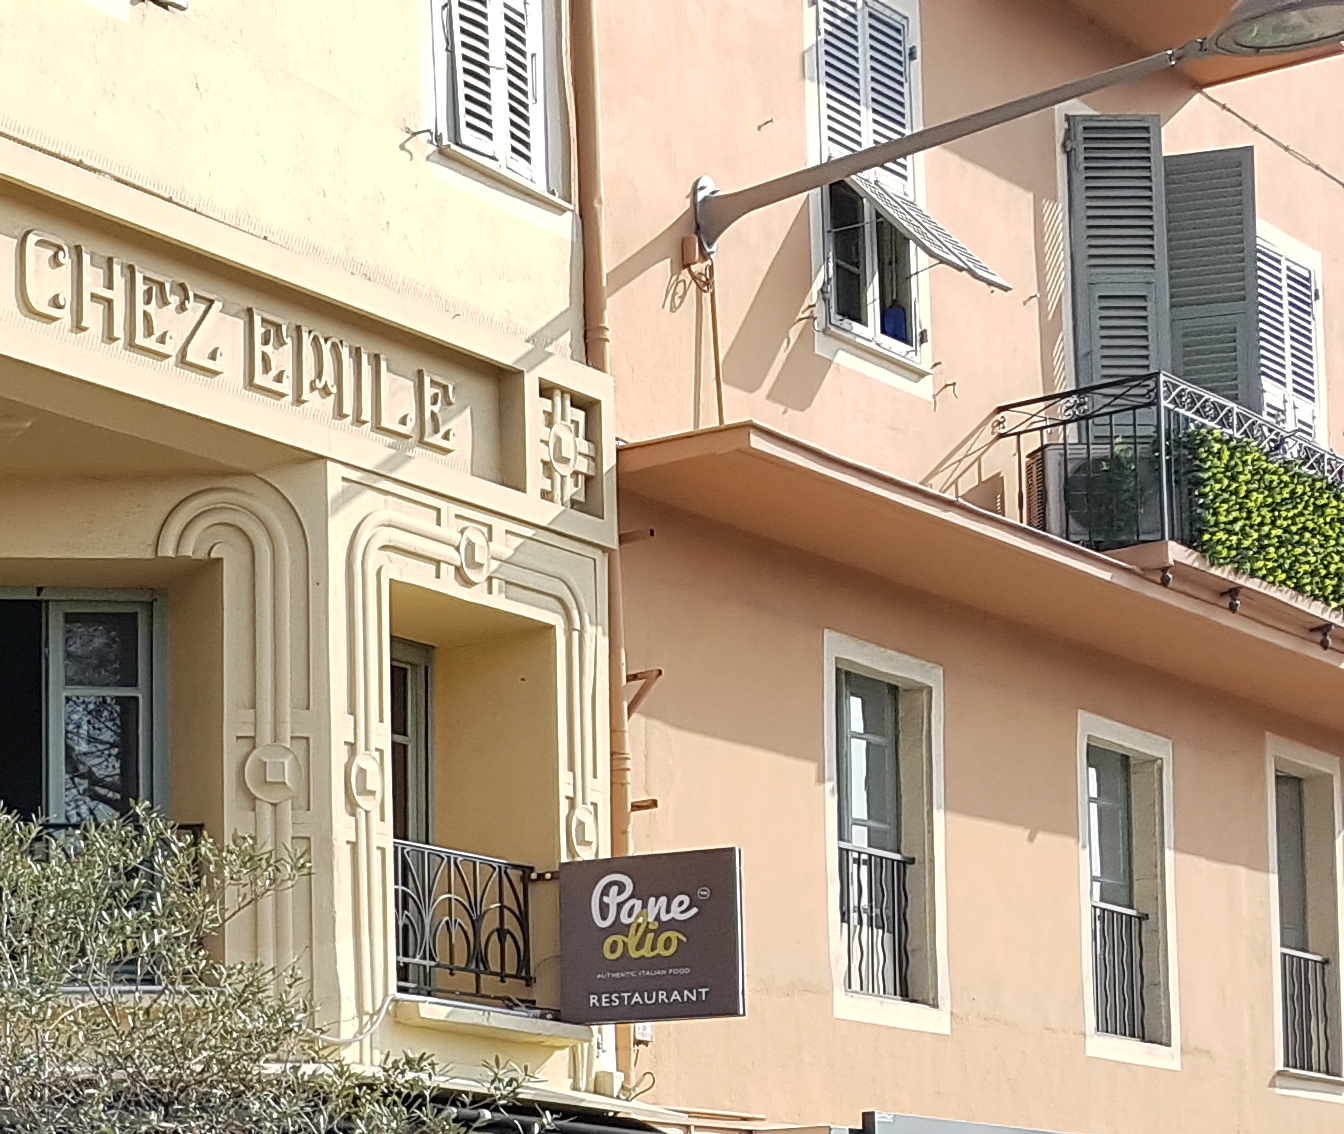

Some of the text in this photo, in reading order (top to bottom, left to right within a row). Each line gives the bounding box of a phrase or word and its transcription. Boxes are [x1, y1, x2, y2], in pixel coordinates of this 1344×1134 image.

[15, 227, 226, 377] CHEZ
[590, 873, 699, 929] Pane
[602, 909, 687, 960] olio
[588, 988, 710, 1008] RESTAURANT
